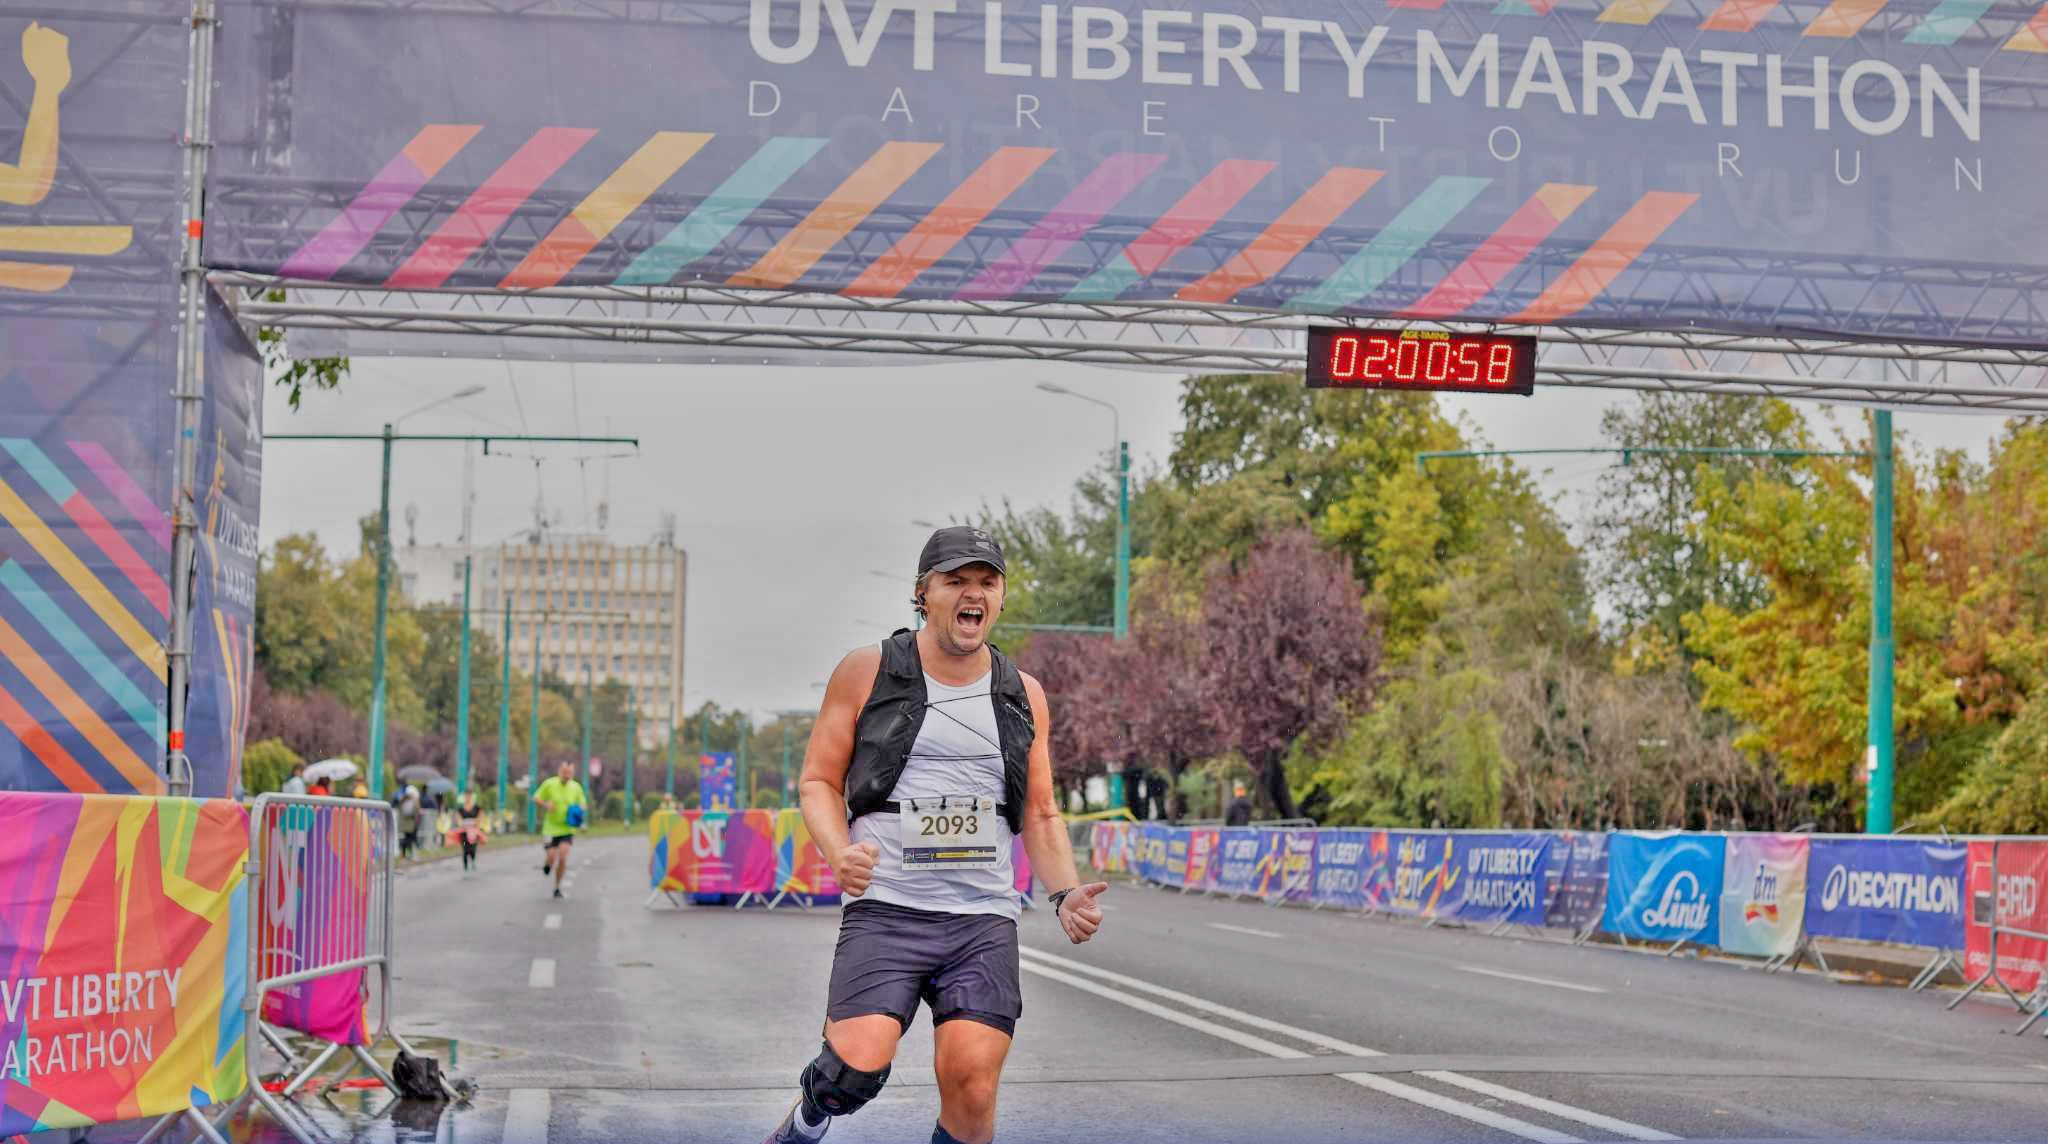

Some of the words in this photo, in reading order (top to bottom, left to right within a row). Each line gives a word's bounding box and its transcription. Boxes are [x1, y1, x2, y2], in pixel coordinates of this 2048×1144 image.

[748, 0, 956, 71] UVT
[984, 2, 1389, 98] LIBERTY
[1416, 29, 1982, 141] MARATHON
[1368, 116, 1522, 161] TO
[1717, 142, 1984, 192] RUN
[1332, 337, 1512, 383] 02:00:58
[921, 815, 978, 835] 2093
[1753, 864, 1777, 900] dm
[1847, 870, 1959, 915] DECATHLON
[1998, 873, 2037, 917] BRD
[53, 967, 183, 1019] LIBERTY
